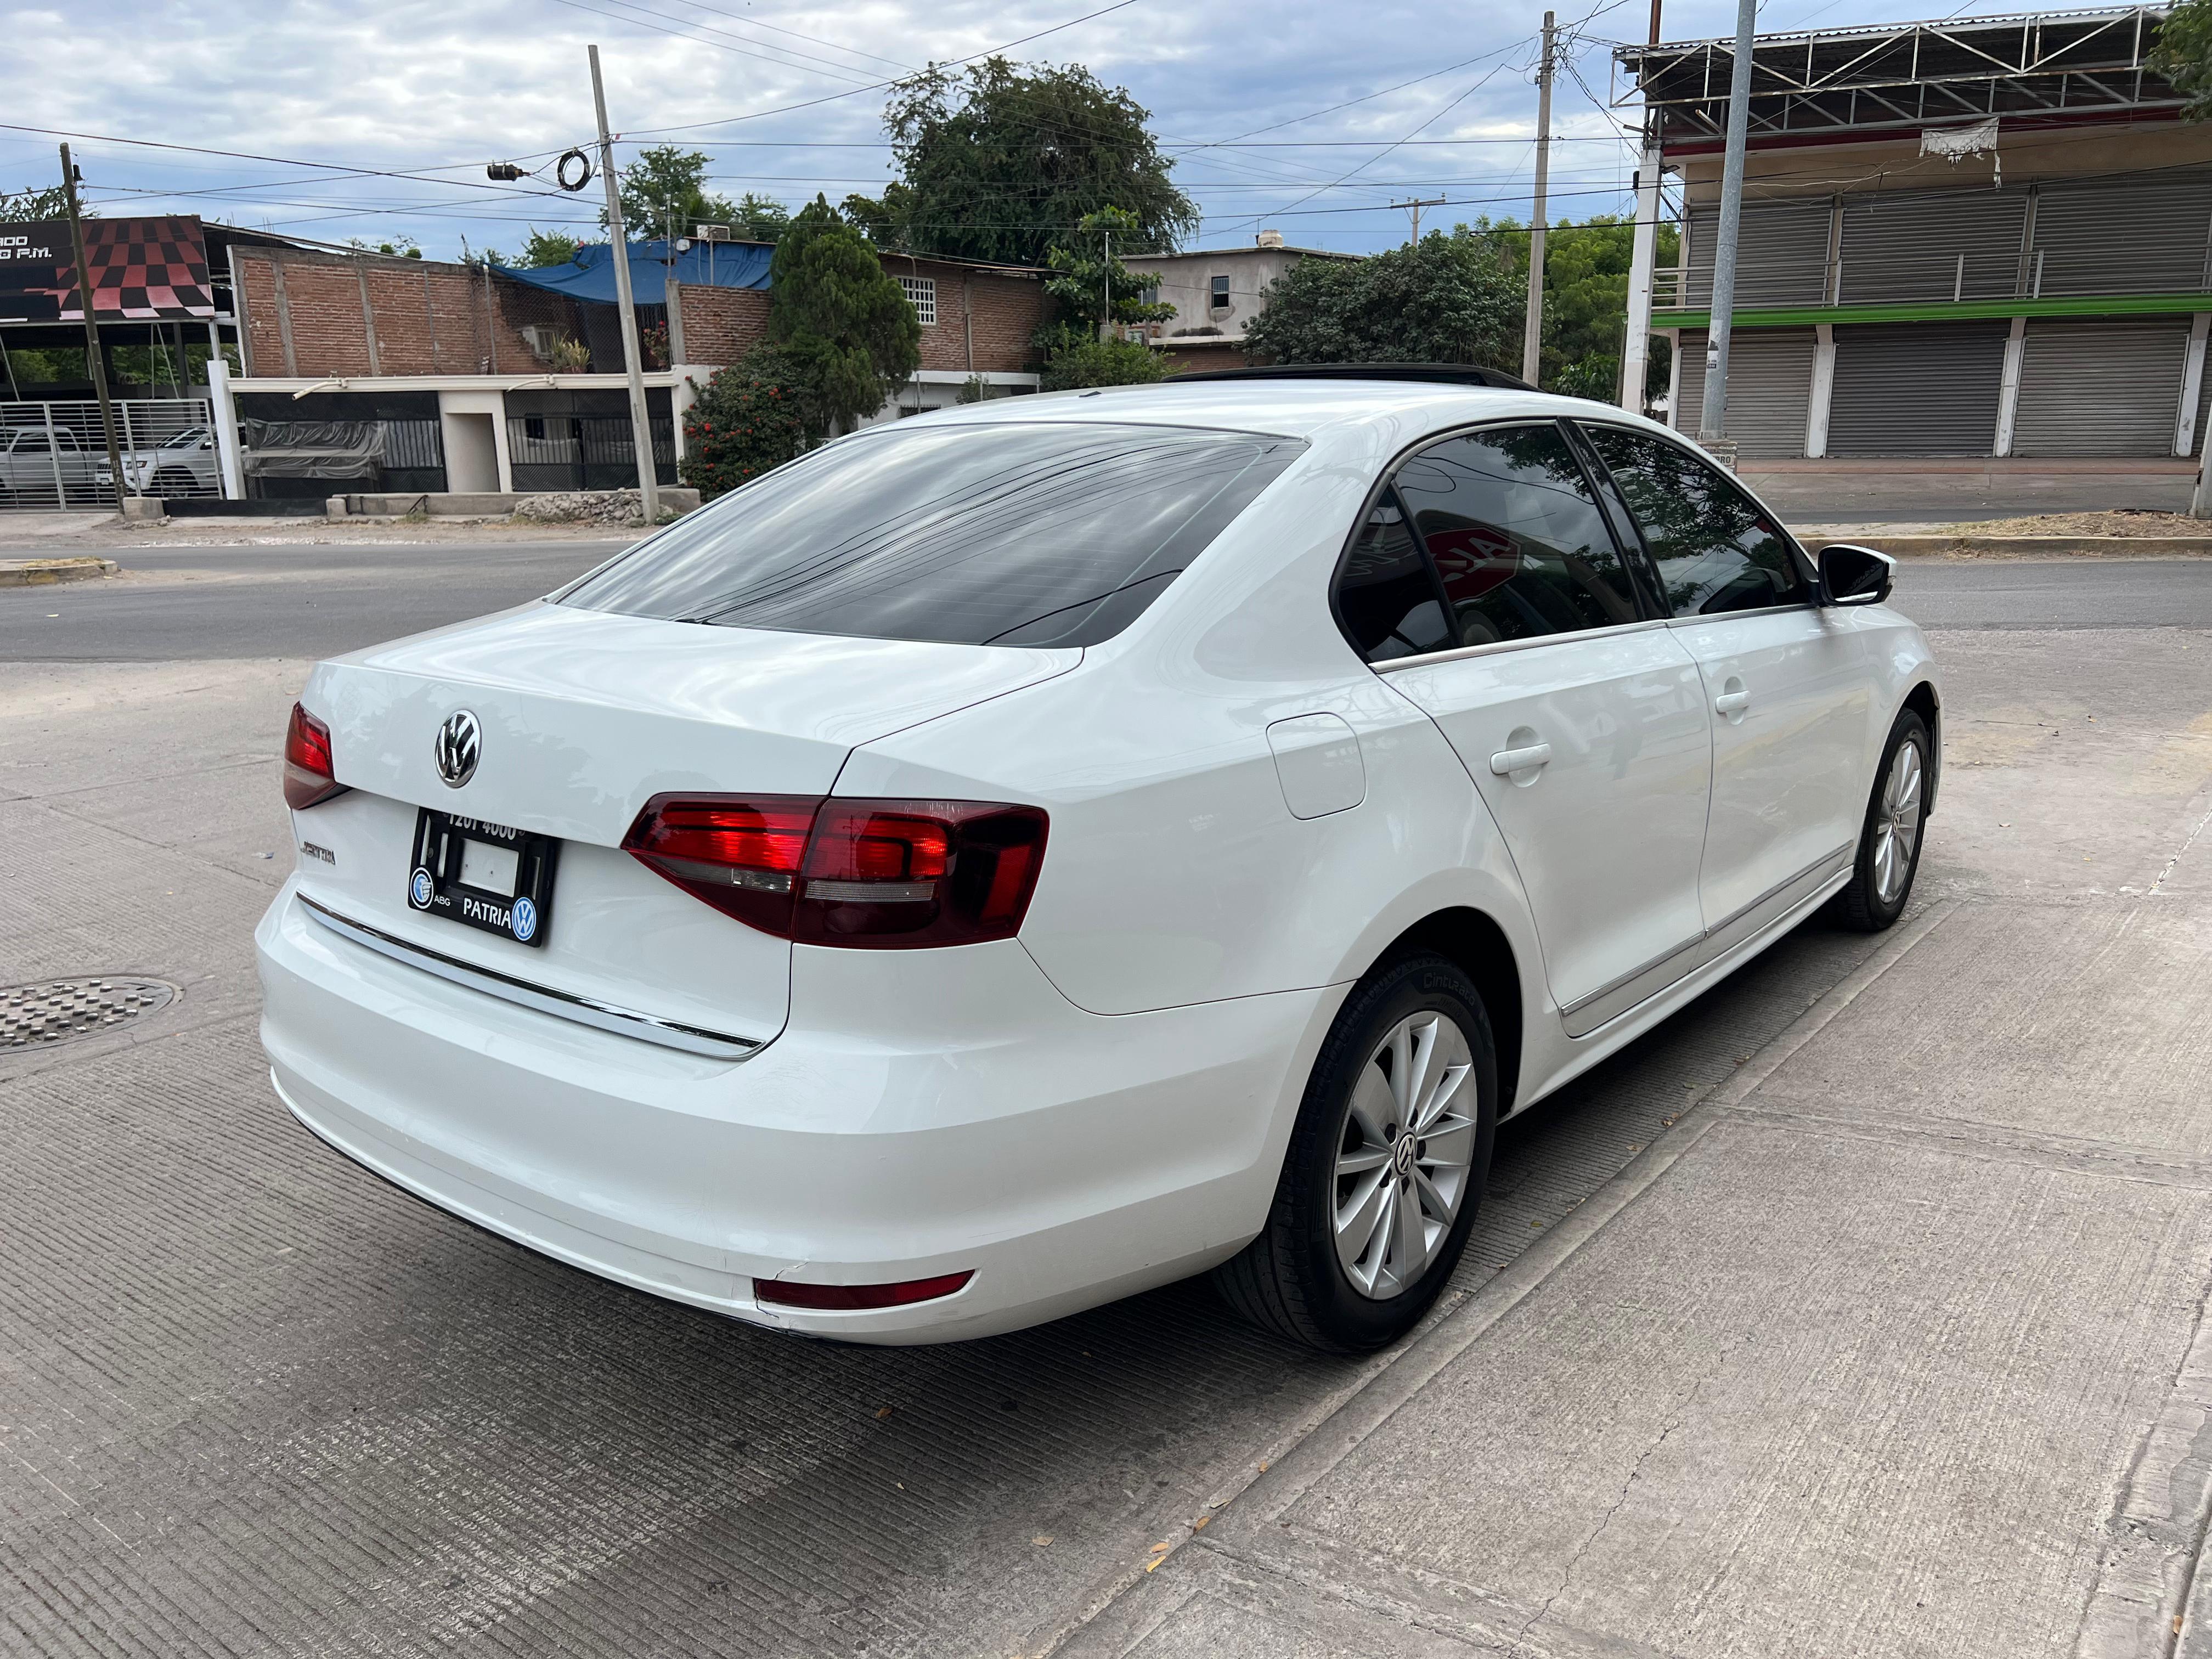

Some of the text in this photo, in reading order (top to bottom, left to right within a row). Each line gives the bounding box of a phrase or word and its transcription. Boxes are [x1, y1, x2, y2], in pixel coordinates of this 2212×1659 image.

[16, 247, 52, 259] P.M.
[434, 895, 451, 906] ABG
[463, 898, 512, 929] PATRIA
